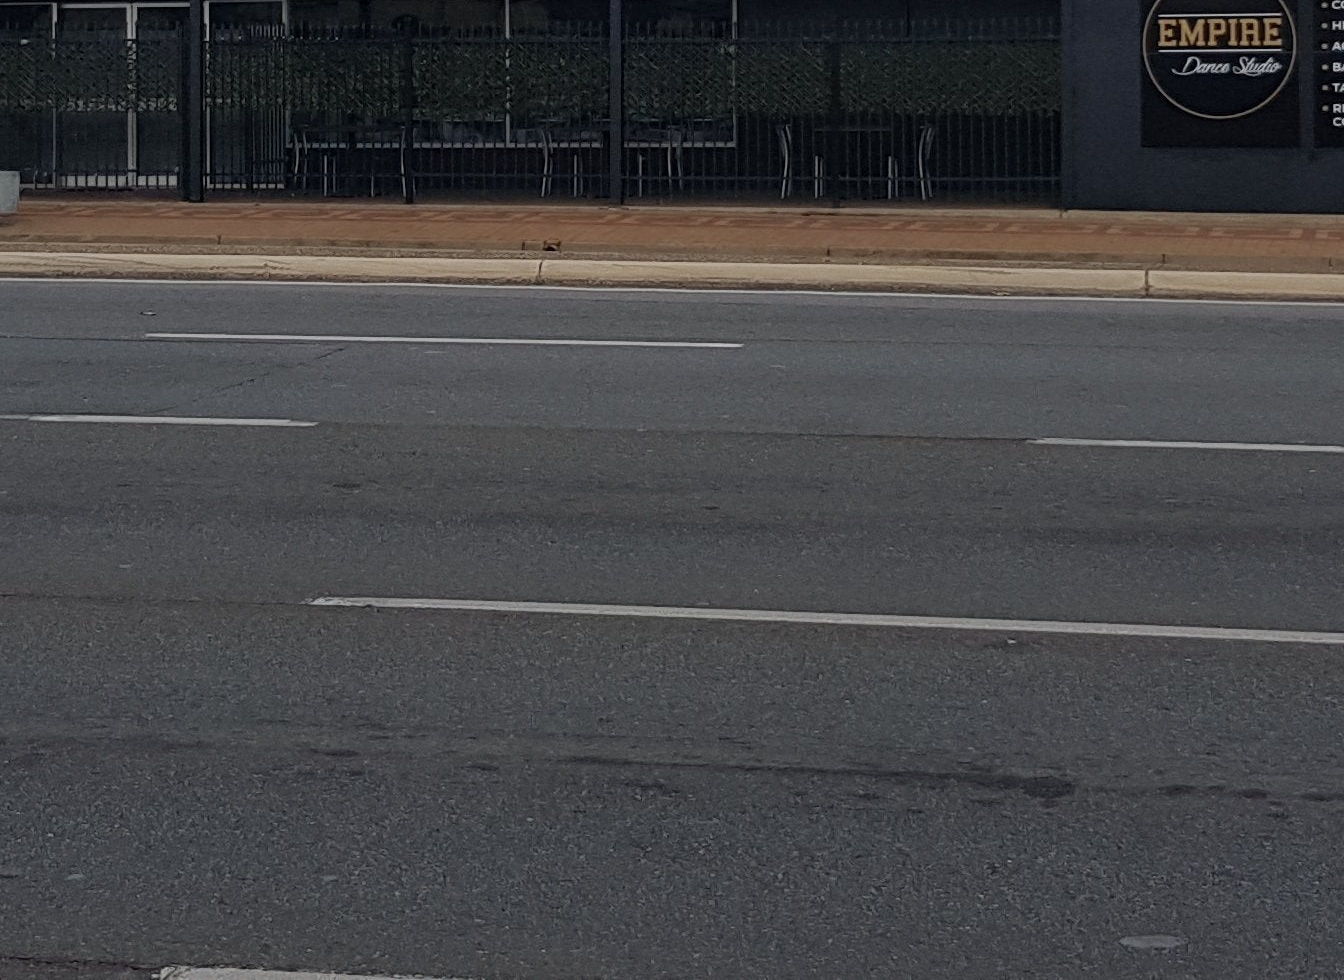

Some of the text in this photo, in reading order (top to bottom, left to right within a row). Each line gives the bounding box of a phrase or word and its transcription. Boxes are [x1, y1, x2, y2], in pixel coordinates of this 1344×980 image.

[1158, 18, 1282, 47] EMPIRE
[1171, 56, 1283, 77] Dance Studio
